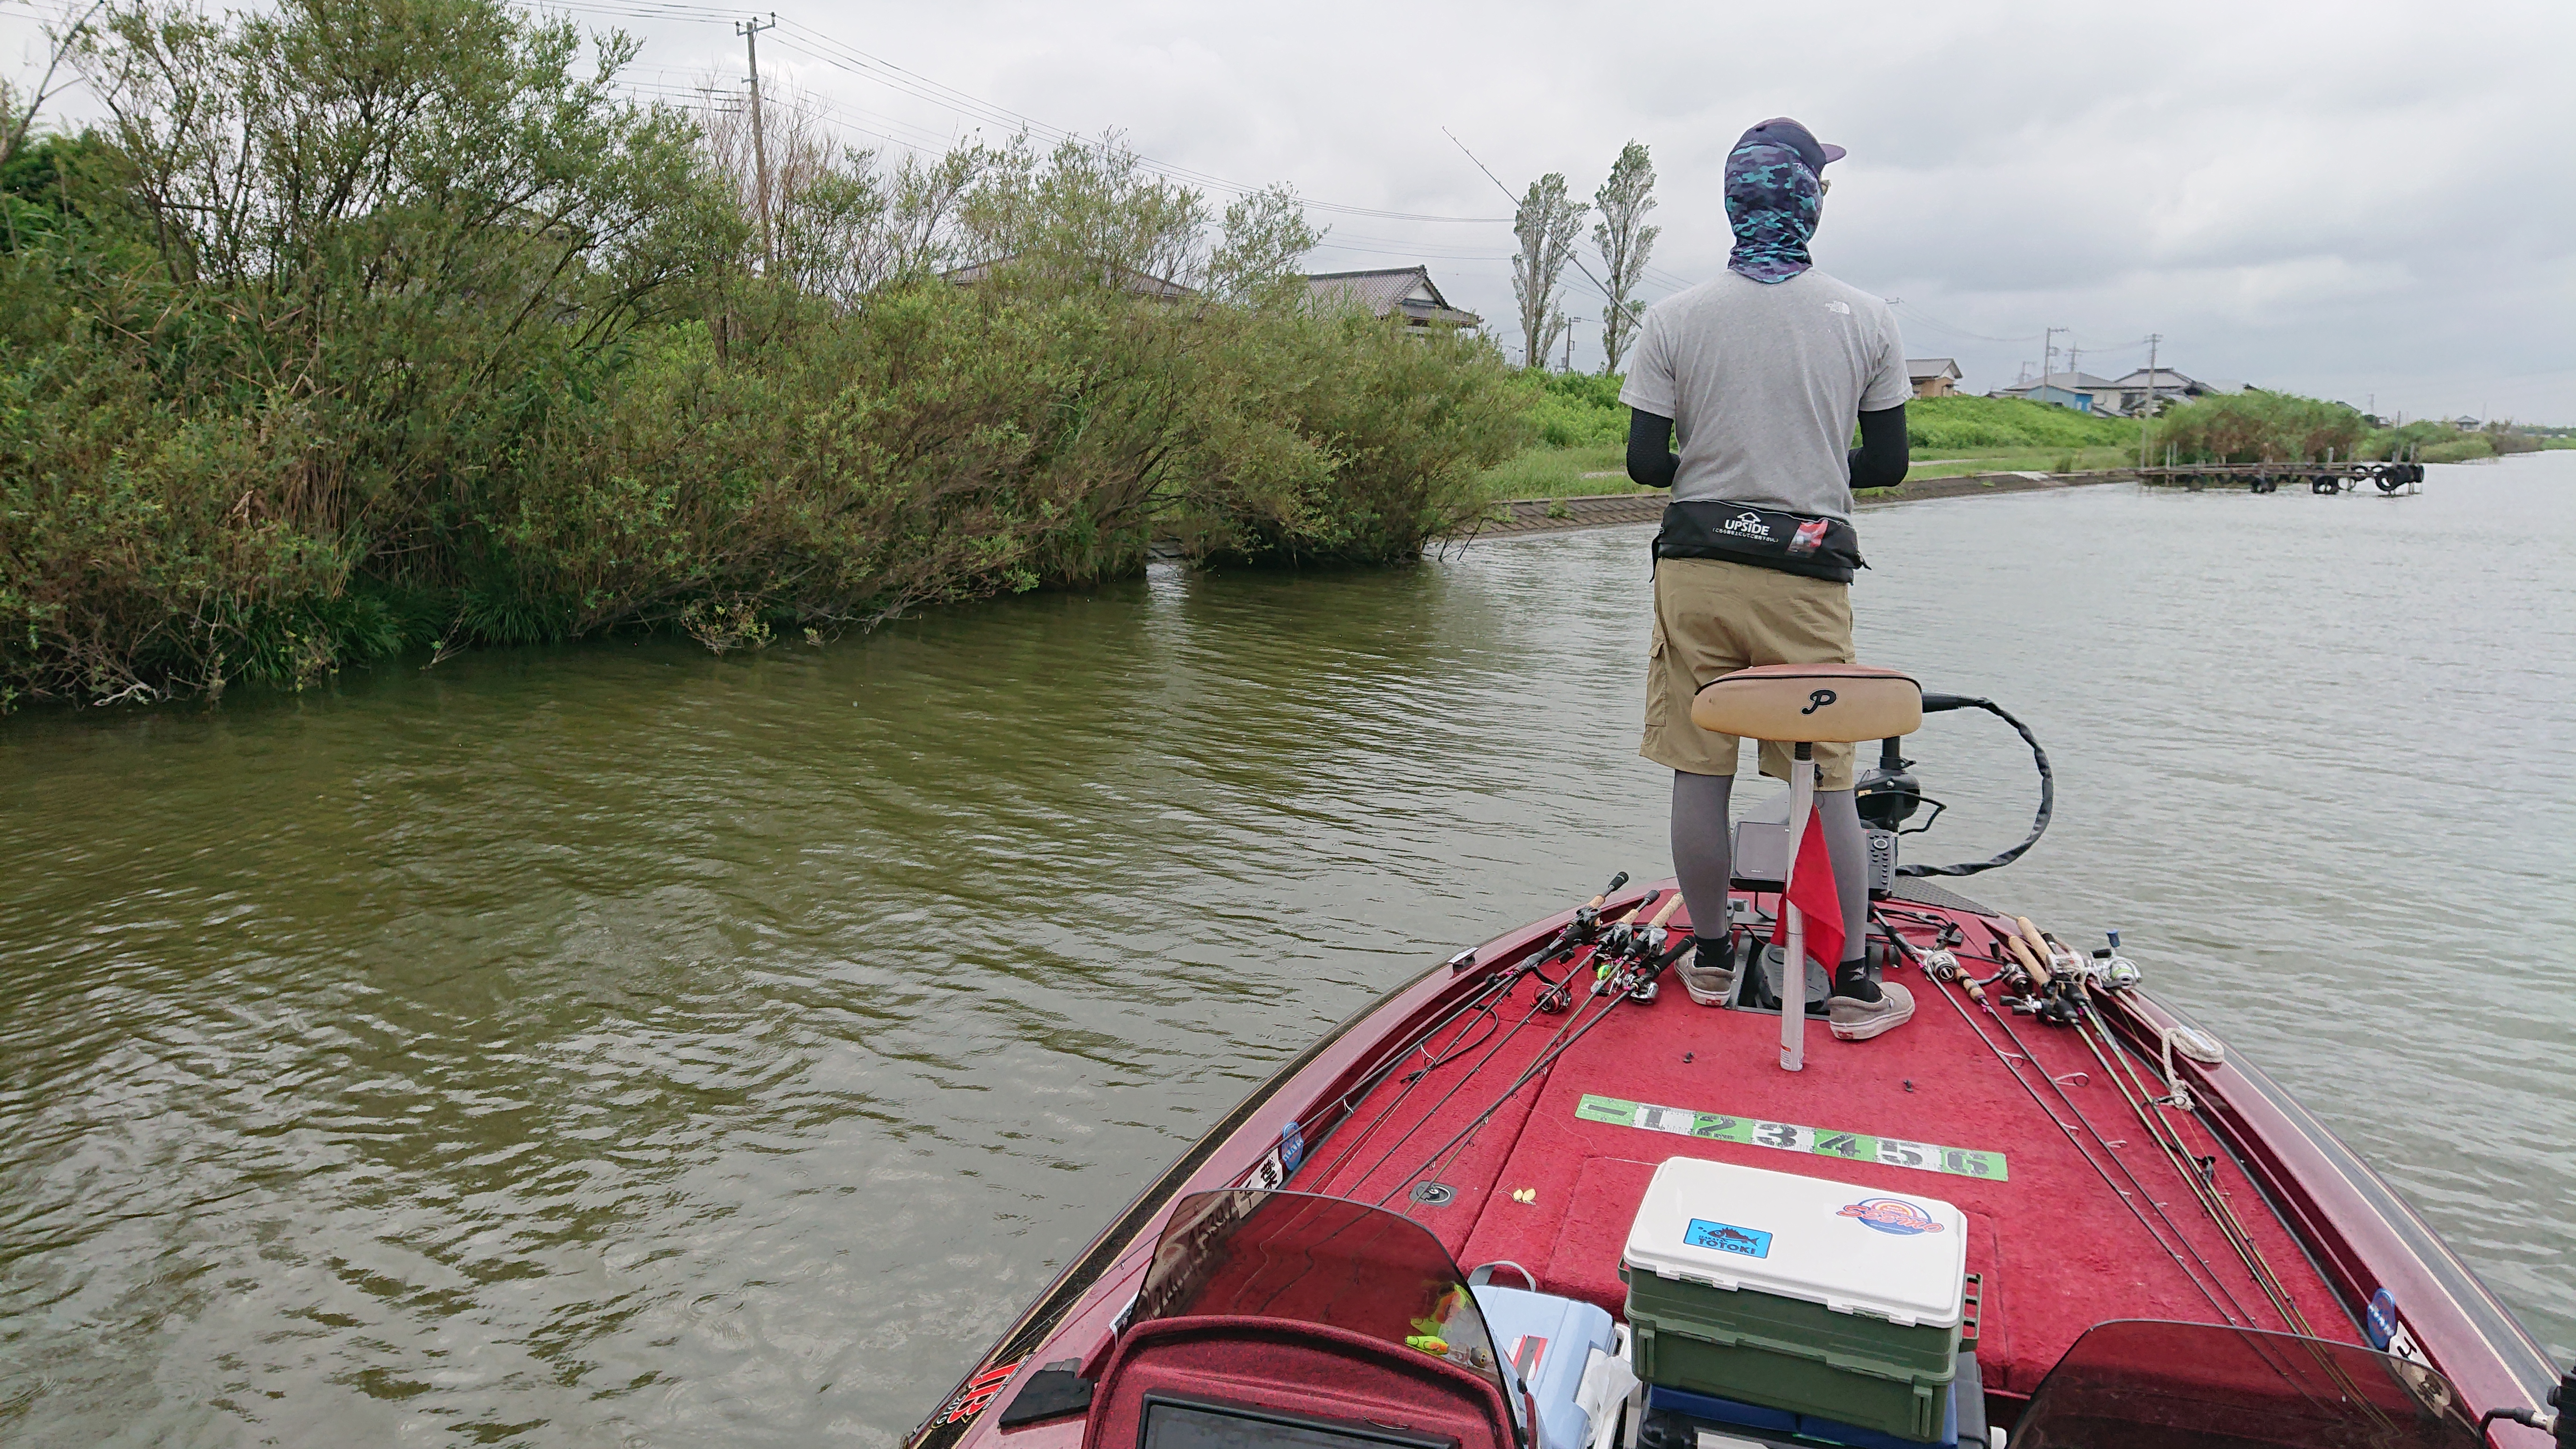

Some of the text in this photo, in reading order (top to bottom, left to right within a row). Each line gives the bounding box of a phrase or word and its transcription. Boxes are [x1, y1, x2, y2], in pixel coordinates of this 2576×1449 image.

[1725, 519, 1771, 536] UPSIDE
[1801, 689, 1837, 715] P
[1696, 1115, 1737, 1139] 2
[1757, 1122, 1797, 1148] 3
[1818, 1133, 1861, 1157] 4
[1882, 1140, 1923, 1166] 5
[1947, 1149, 1990, 1176] 6
[1698, 1237, 1756, 1254] TOTOKI
[936, 1394, 966, 1425] 2019
